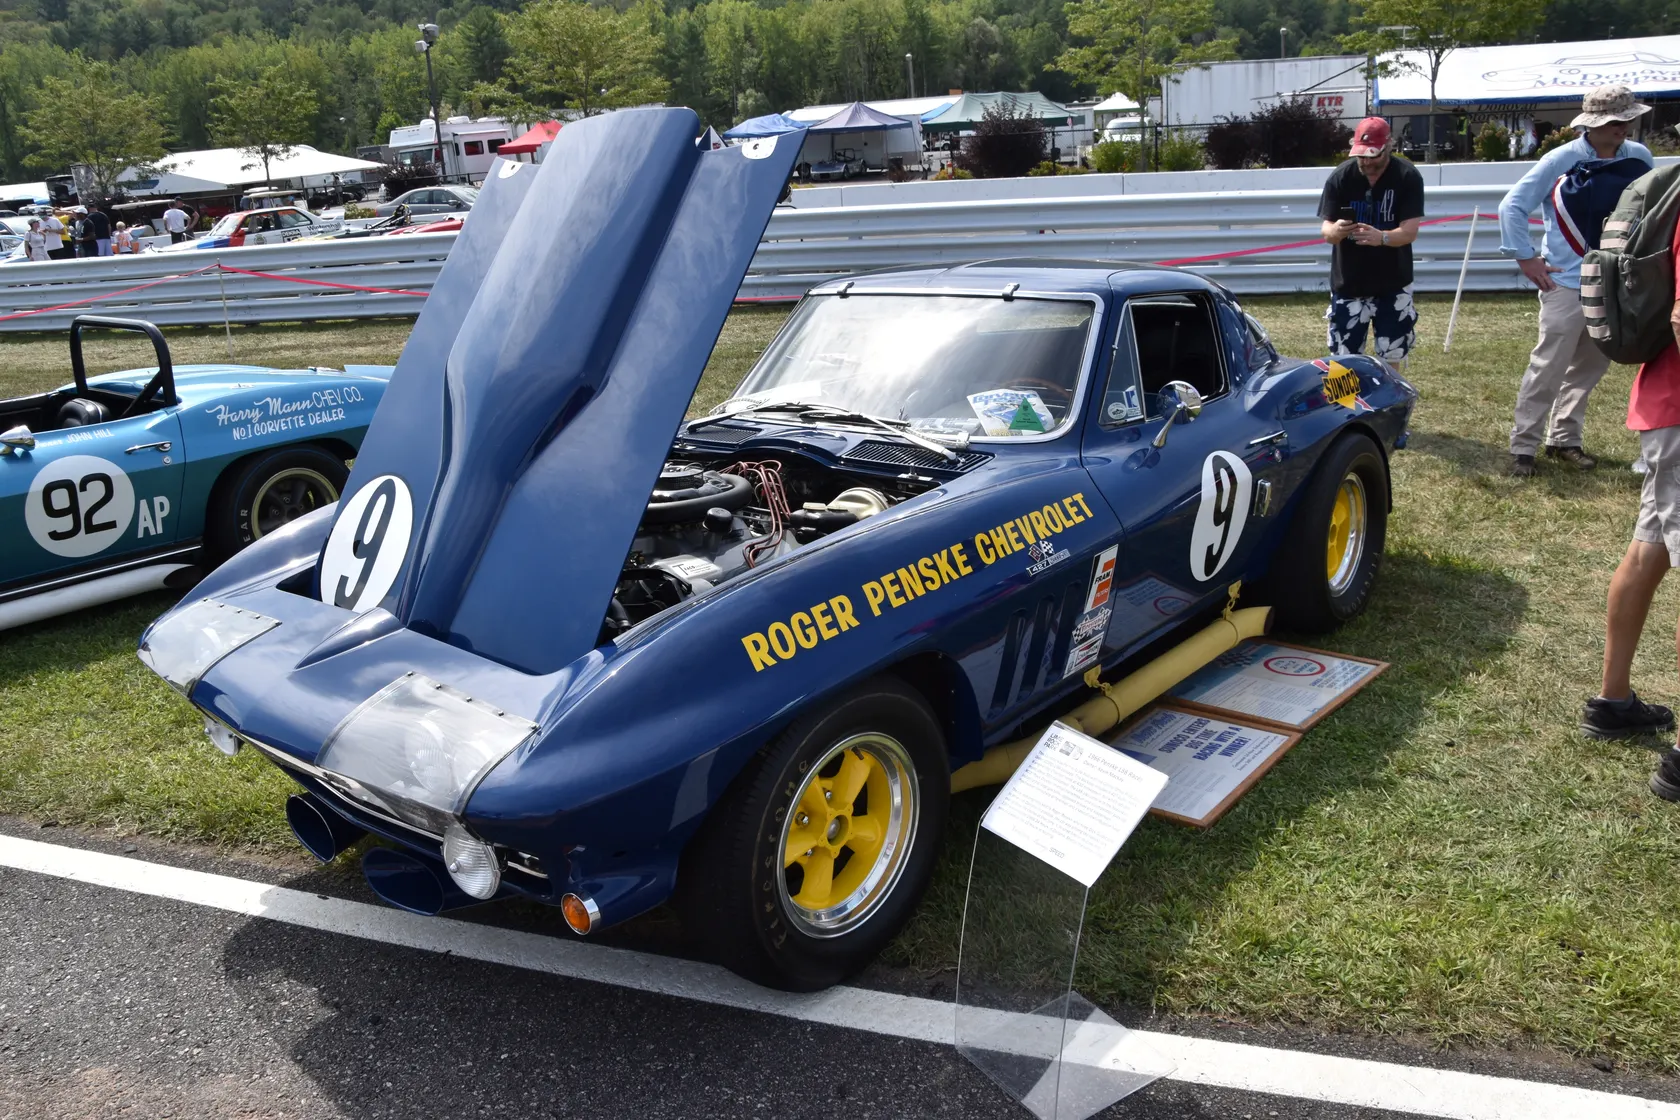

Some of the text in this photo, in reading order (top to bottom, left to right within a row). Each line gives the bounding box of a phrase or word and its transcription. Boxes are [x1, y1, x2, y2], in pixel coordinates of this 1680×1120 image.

[1317, 95, 1344, 107] KTR
[1380, 188, 1395, 223] 42
[282, 229, 300, 237] DEKRA
[1323, 369, 1360, 402] SUNOCO
[205, 404, 263, 427] Harry
[254, 397, 314, 417] Mann
[344, 386, 364, 403] CO.
[254, 414, 306, 436] CORVETTE
[308, 407, 346, 426] DEALER
[66, 431, 93, 444] JOHN
[93, 428, 115, 439] HILL
[42, 472, 118, 541] 92
[137, 495, 170, 539] AP
[1204, 454, 1238, 578] 9
[334, 478, 396, 611] 9
[1032, 561, 1048, 572] 427
[741, 492, 1094, 672] ROGER PENSKE CHEVROLET
[1094, 571, 1111, 585] FRAM
[1043, 741, 1057, 751] PARK
[1046, 737, 1060, 747] ROCK
[1050, 732, 1065, 742] LIME
[1158, 718, 1210, 753] SUNOCO ENTERS
[1185, 728, 1218, 749] BIG TIME
[1192, 742, 1222, 761] RACING
[1213, 730, 1237, 743] WITH
[1218, 736, 1251, 757] WINNER!
[1087, 752, 1102, 765] 1966
[1100, 757, 1119, 772] Penske
[1048, 847, 1066, 859] SPEED
